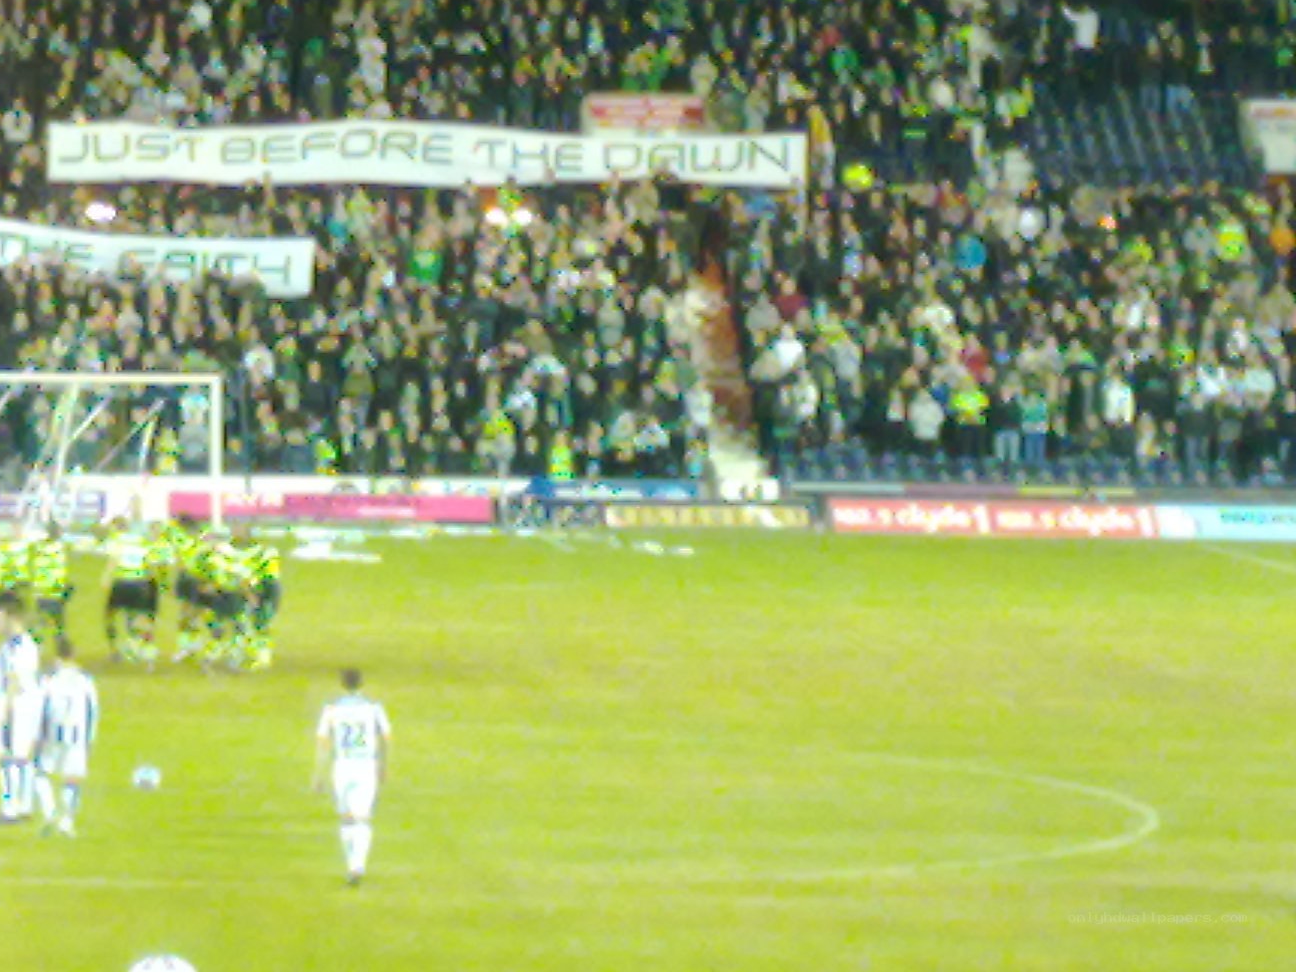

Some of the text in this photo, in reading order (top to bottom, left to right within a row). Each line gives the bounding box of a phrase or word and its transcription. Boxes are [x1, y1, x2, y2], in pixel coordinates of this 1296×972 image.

[57, 128, 791, 173] JUST BEFORE THE DAWN
